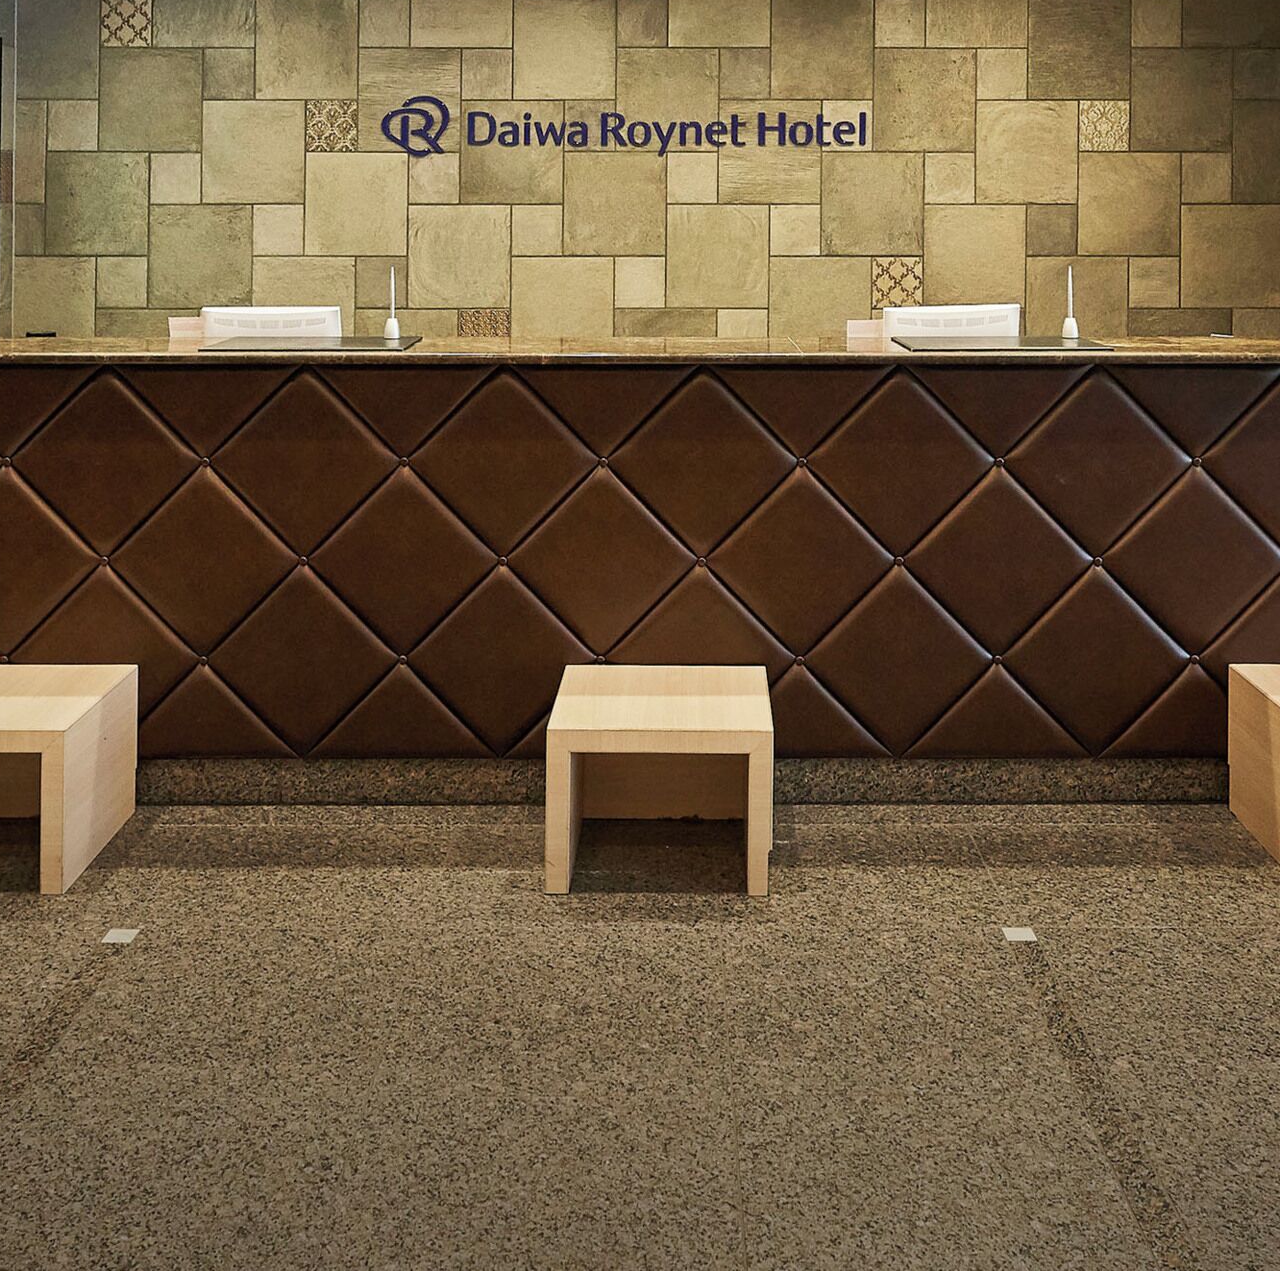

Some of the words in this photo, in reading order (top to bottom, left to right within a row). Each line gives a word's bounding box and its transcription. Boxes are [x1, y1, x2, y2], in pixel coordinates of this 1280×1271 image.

[467, 111, 588, 147] Daiwa
[600, 112, 746, 157] Roynet
[757, 111, 867, 147] Hotel
